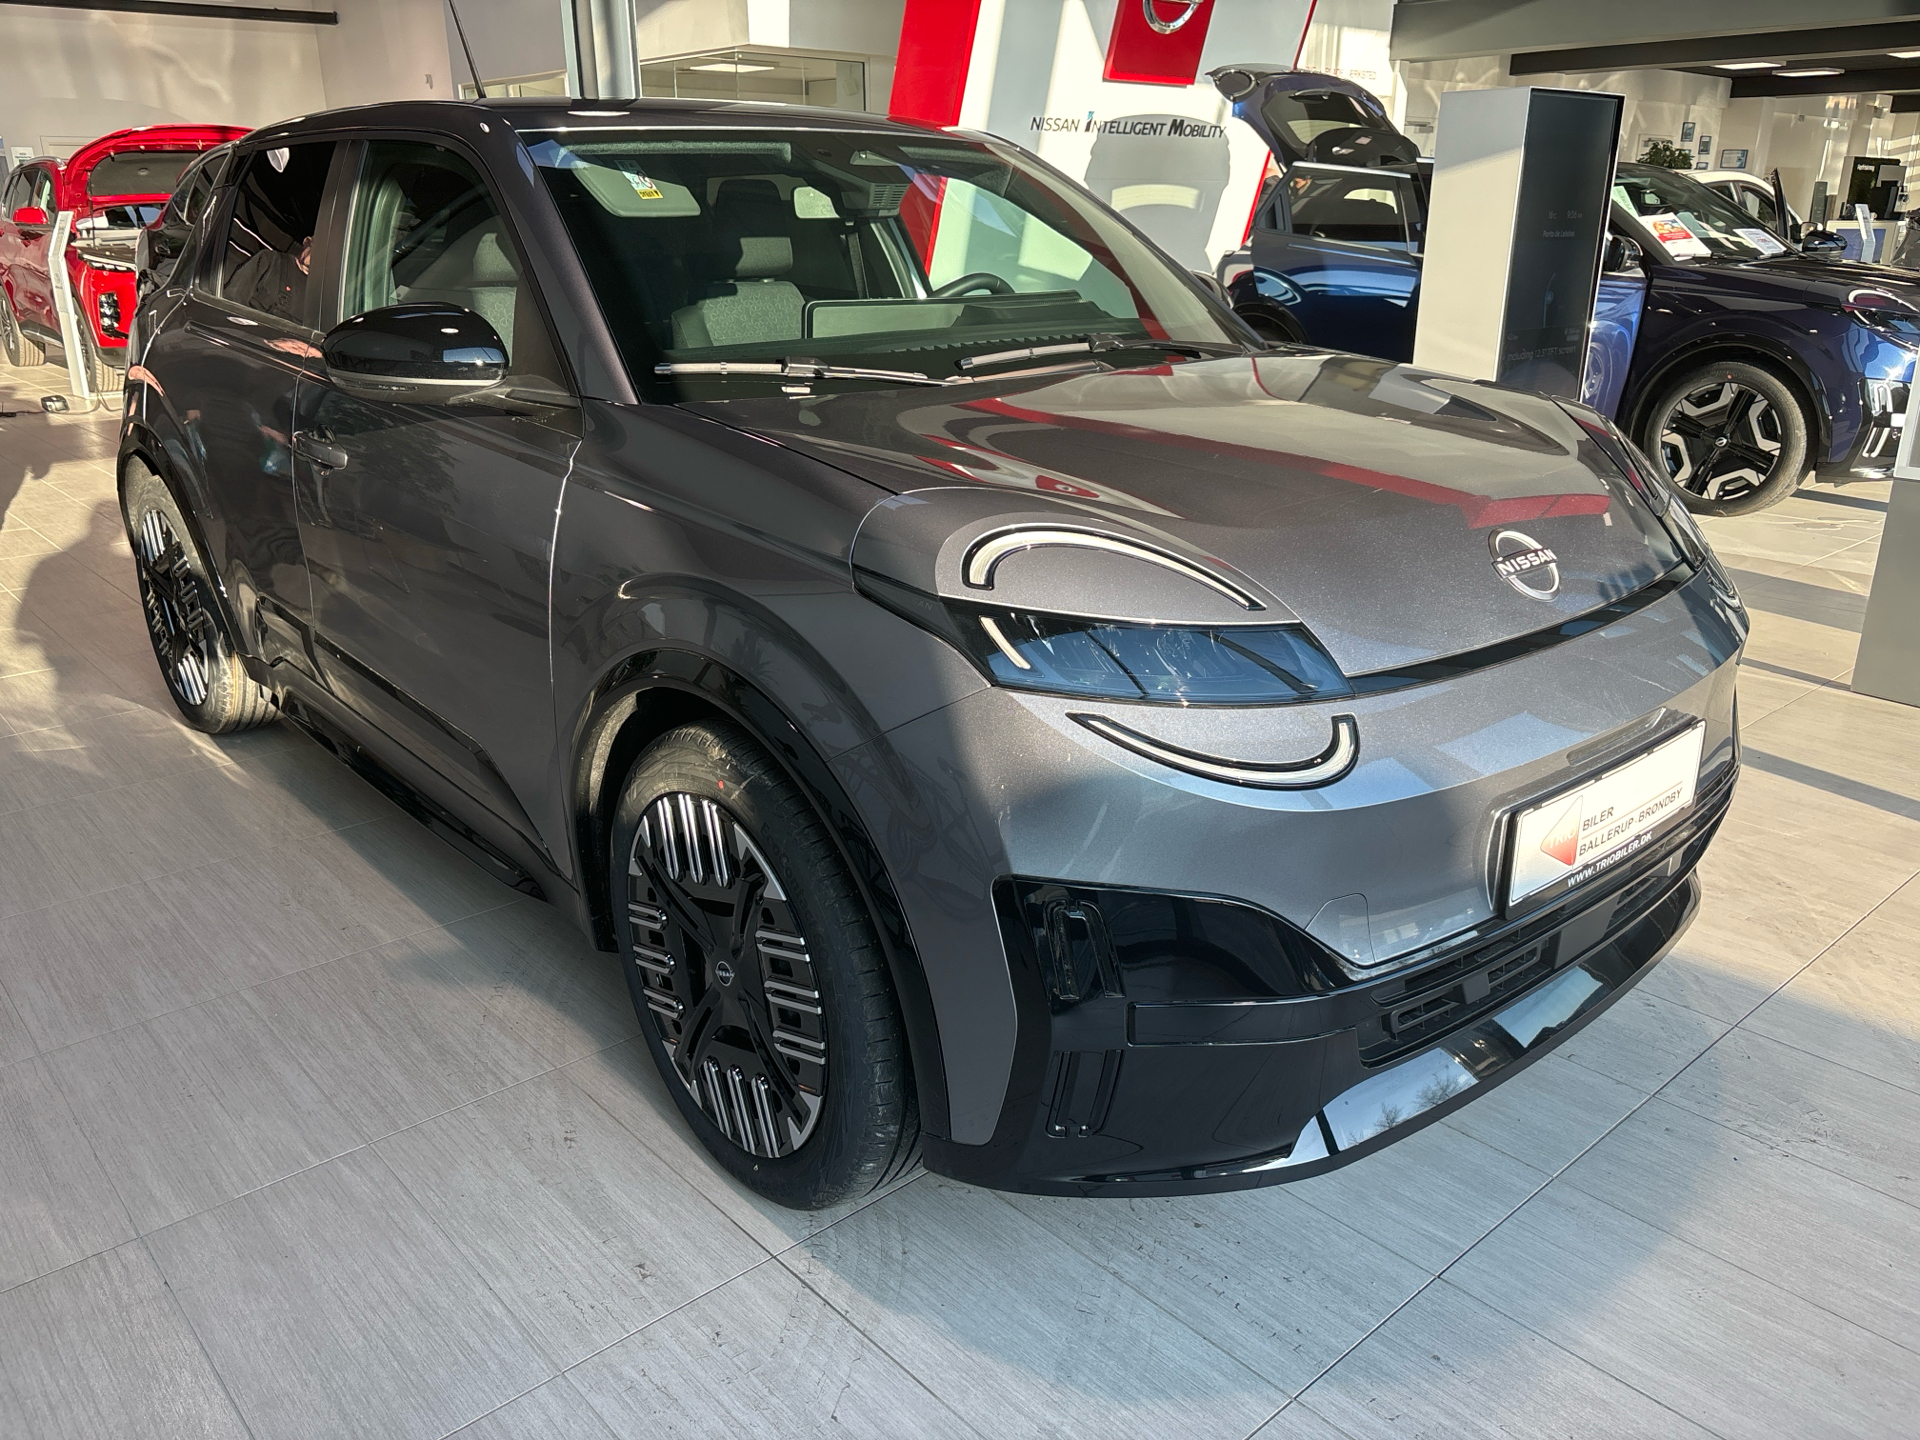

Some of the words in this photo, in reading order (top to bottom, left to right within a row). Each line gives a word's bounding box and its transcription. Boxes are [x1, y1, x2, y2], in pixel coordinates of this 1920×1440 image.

[1030, 116, 1080, 133] NISSAN
[1167, 118, 1227, 139] MOBILITY
[1497, 549, 1557, 575] NISSAN
[1582, 806, 1614, 832] BILER
[1567, 831, 1652, 887] WWW.TRIOBILER.DK
